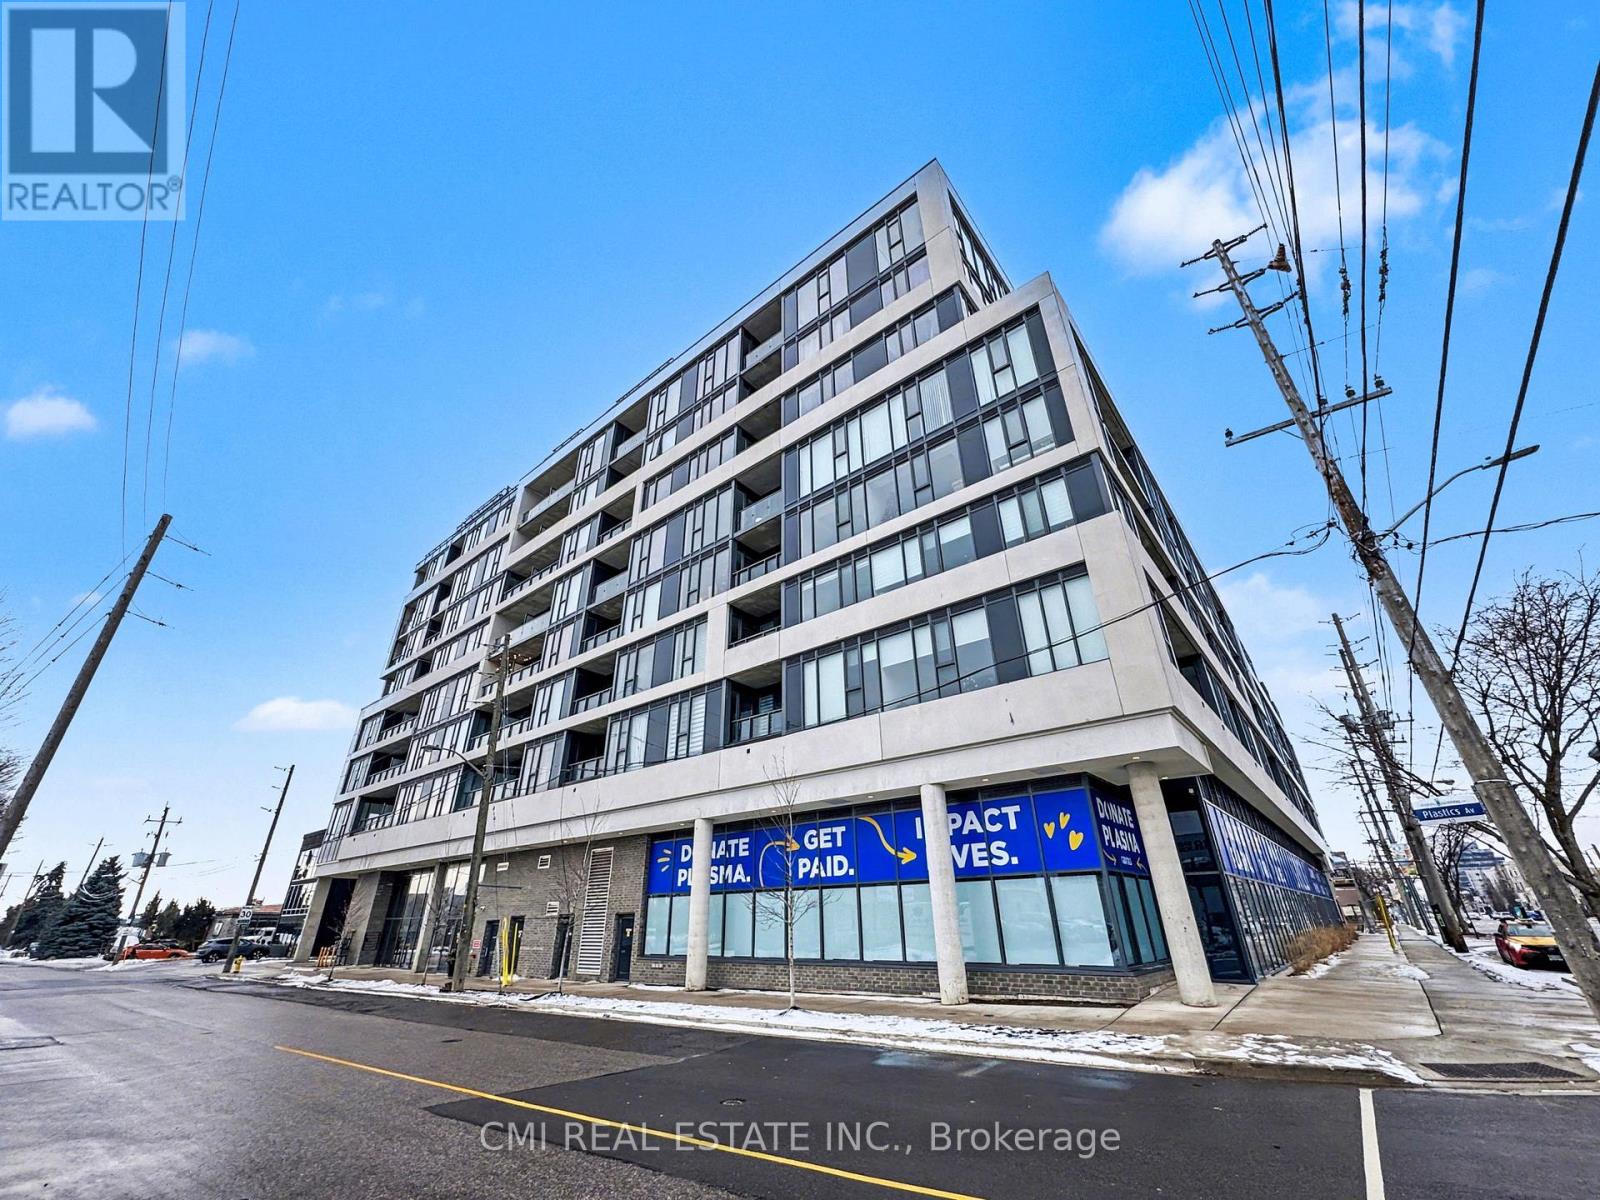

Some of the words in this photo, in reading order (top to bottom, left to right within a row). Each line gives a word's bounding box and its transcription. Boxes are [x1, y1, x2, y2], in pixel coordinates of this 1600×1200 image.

[915, 805, 1020, 839] IPACT
[1422, 807, 1460, 819] Plastics
[681, 837, 749, 862] DATE
[804, 826, 846, 850] GET
[798, 855, 854, 879] PAID.
[950, 841, 1019, 869] VES.
[677, 864, 750, 886] PLSMA.
